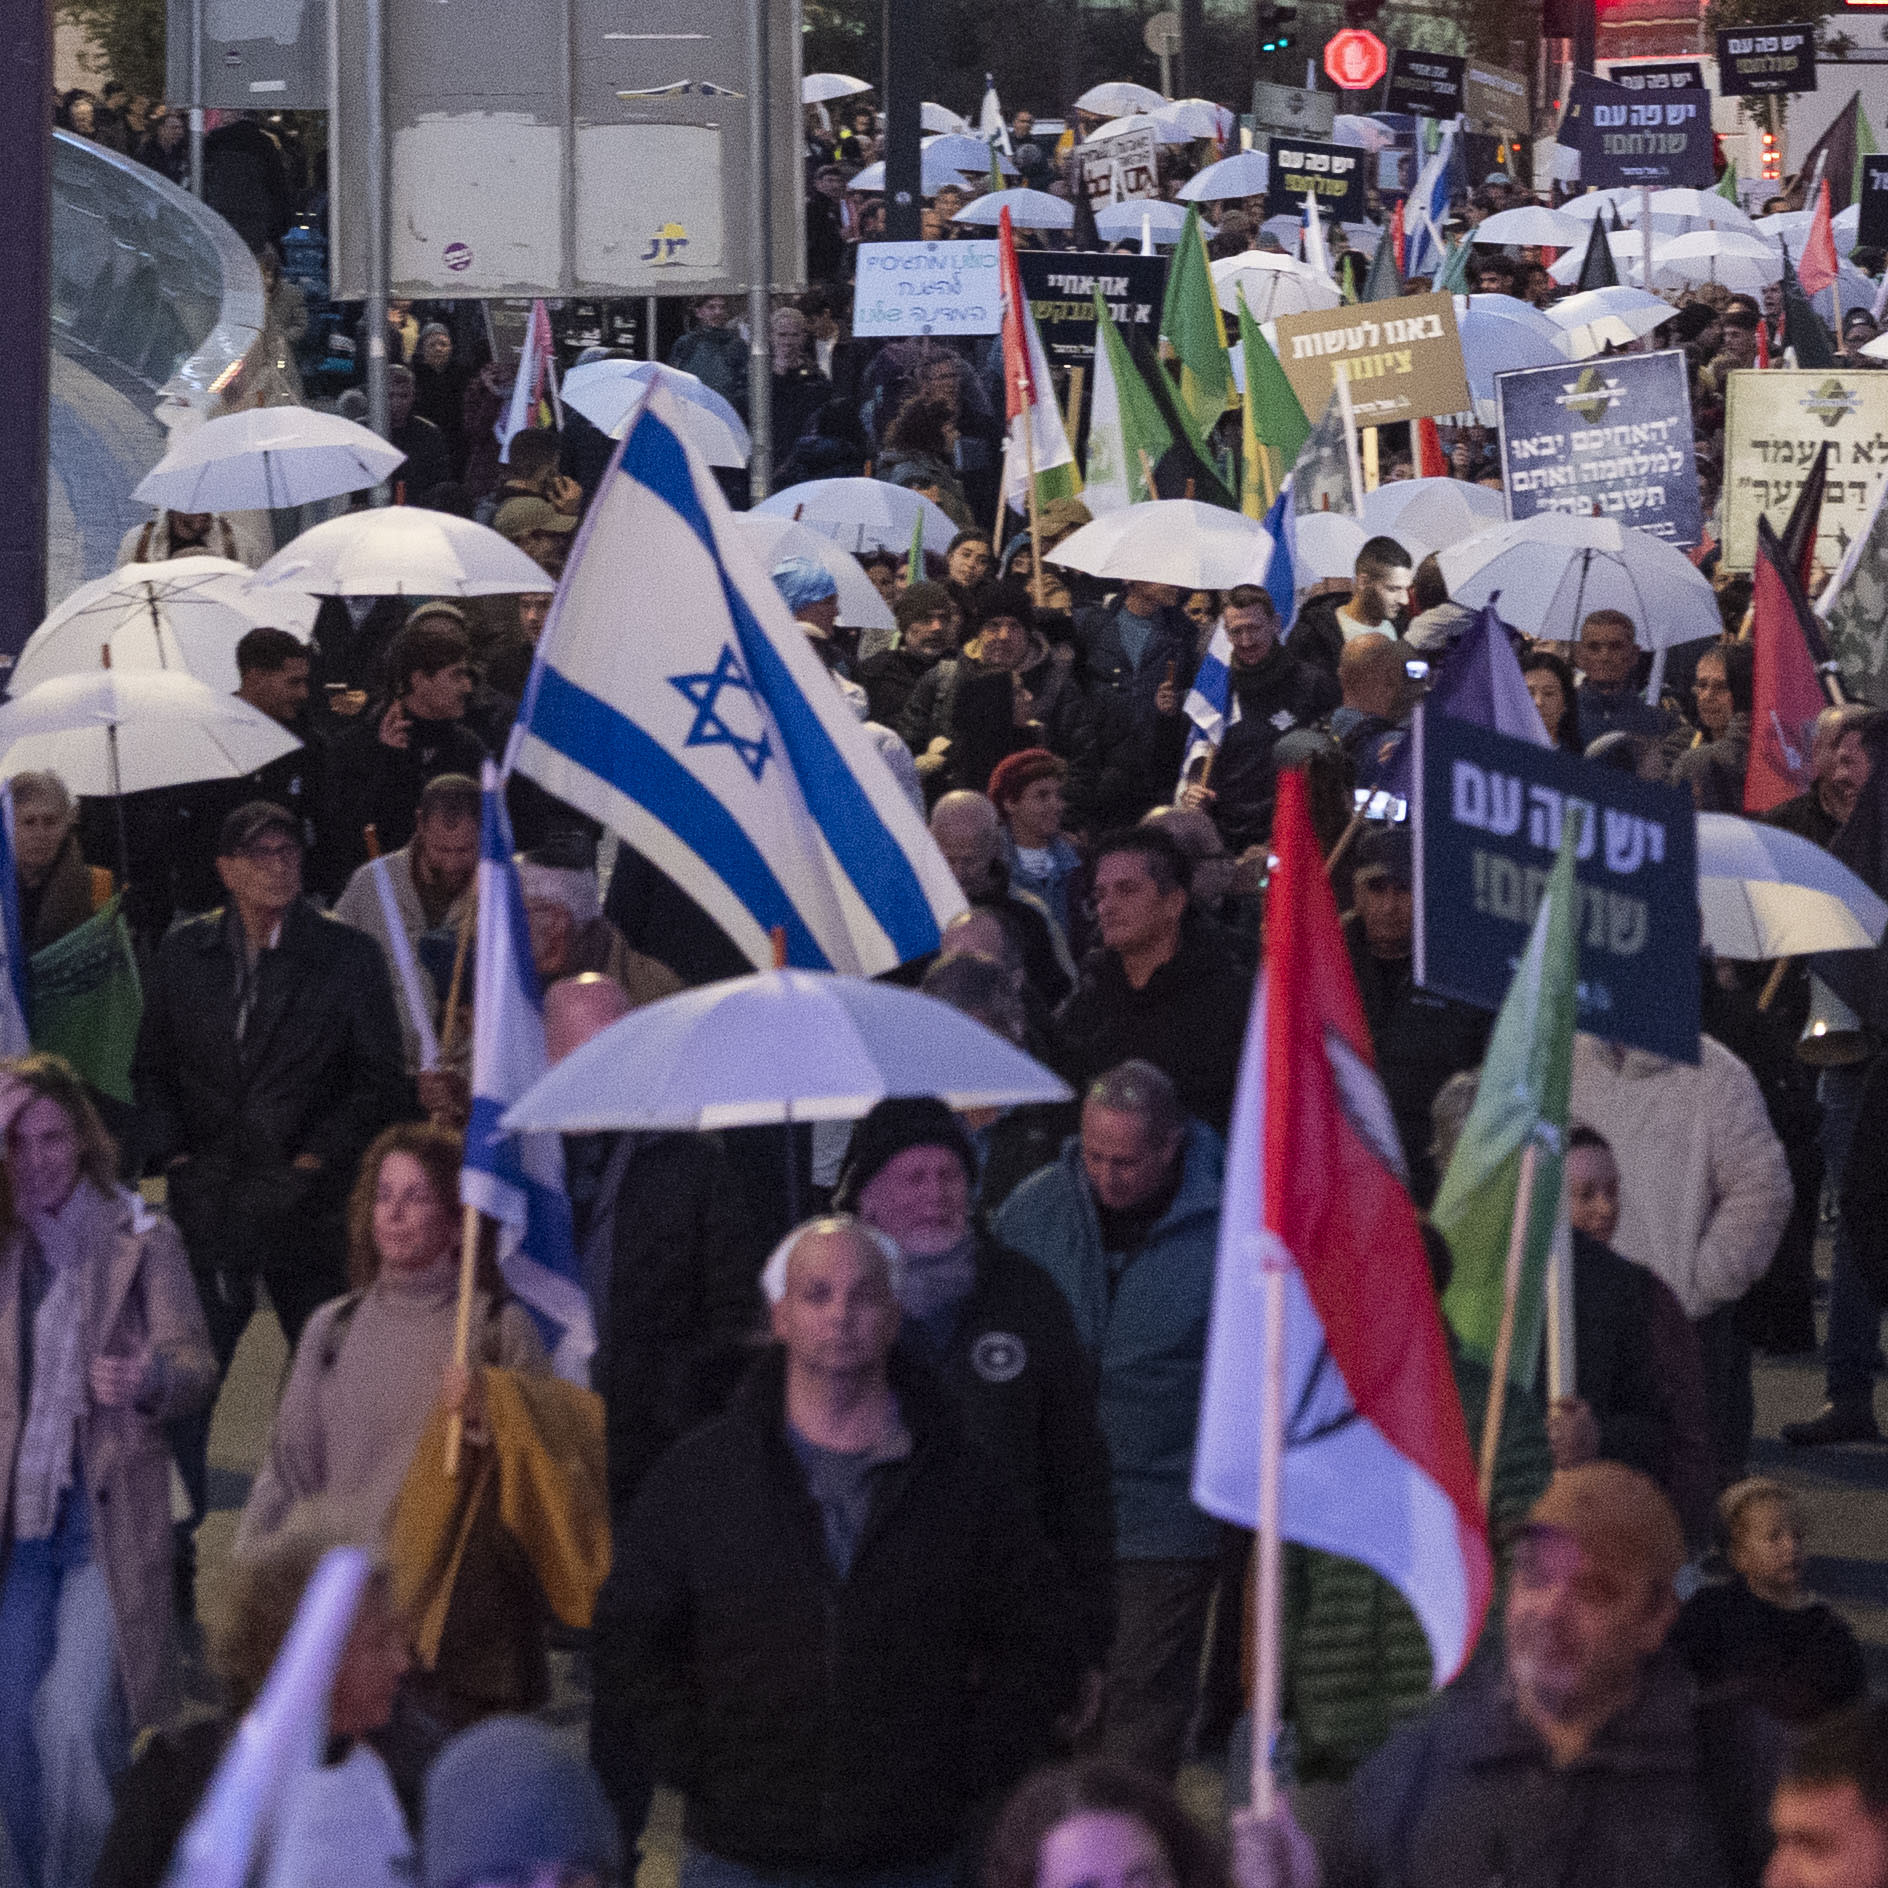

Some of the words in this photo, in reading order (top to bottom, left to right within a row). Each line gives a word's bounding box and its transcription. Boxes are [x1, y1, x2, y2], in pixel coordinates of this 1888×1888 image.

[1727, 38, 1754, 55] עם
[1754, 36, 1780, 53] פה
[1780, 34, 1804, 52] יש
[1592, 104, 1627, 127] עם
[1629, 104, 1663, 127] פה
[1665, 104, 1697, 126] יש
[1602, 129, 1689, 155] שנלחם!
[1291, 319, 1381, 360] לעשות
[1383, 313, 1445, 345] באנו
[1452, 759, 1523, 837] עם
[1529, 784, 1597, 860] פה
[1603, 807, 1666, 875] יש
